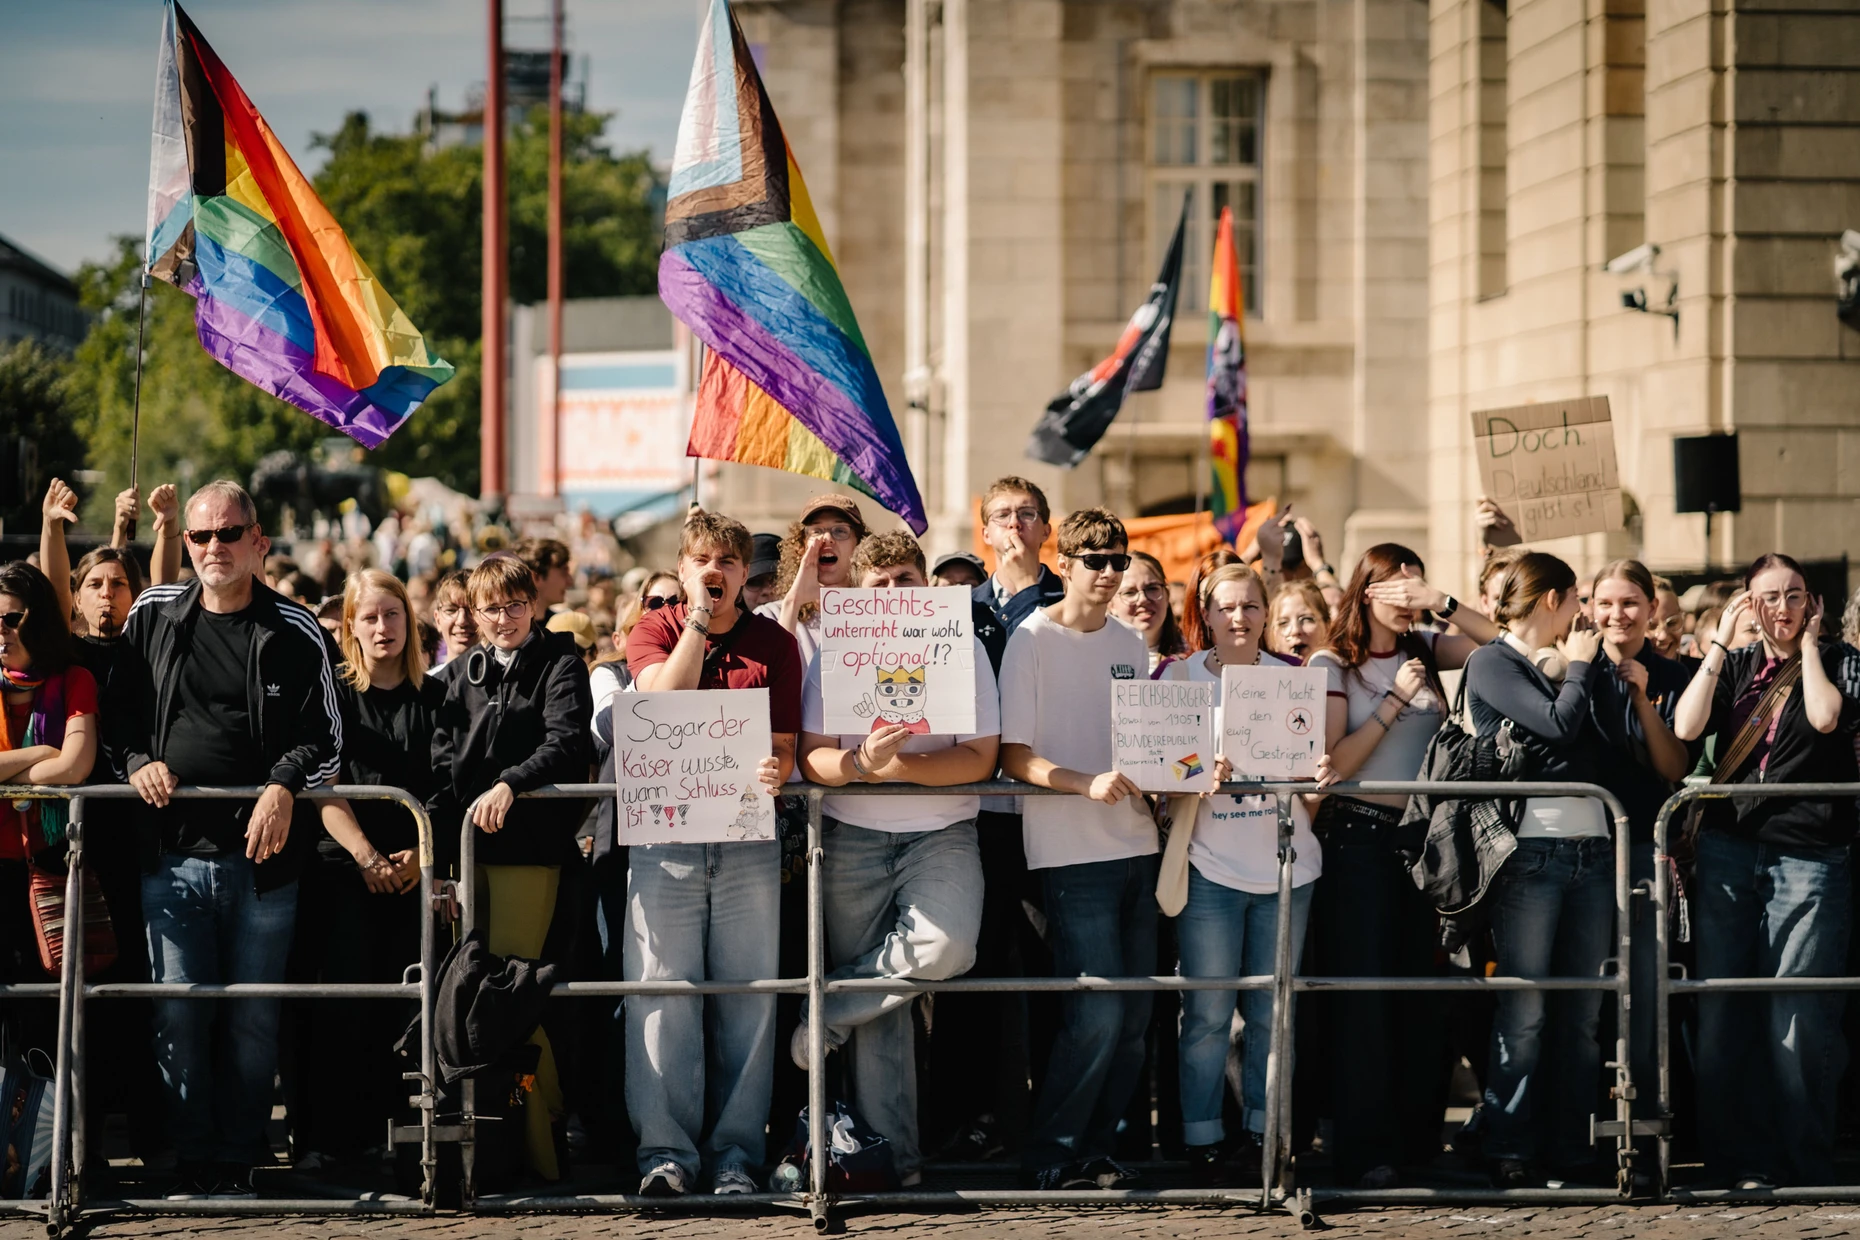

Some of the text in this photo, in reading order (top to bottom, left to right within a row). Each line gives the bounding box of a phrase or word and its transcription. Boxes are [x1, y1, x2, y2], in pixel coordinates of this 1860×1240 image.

[823, 589, 949, 617] Geschichts-
[824, 619, 963, 638] unterricht war wohl
[843, 642, 952, 676] optional!?
[1229, 680, 1316, 700] Keine Macht
[627, 699, 750, 750] Sogar der
[1249, 710, 1272, 721] den
[1116, 732, 1199, 748] BUNDESREPUBLIK
[1226, 726, 1251, 747] ewig
[622, 748, 673, 779] Kaiser
[1251, 741, 1314, 771] Gestrigen!
[621, 774, 737, 805] wann Schluss
[1212, 810, 1228, 821] hey
[1230, 811, 1246, 819] see
[1249, 809, 1263, 818] me
